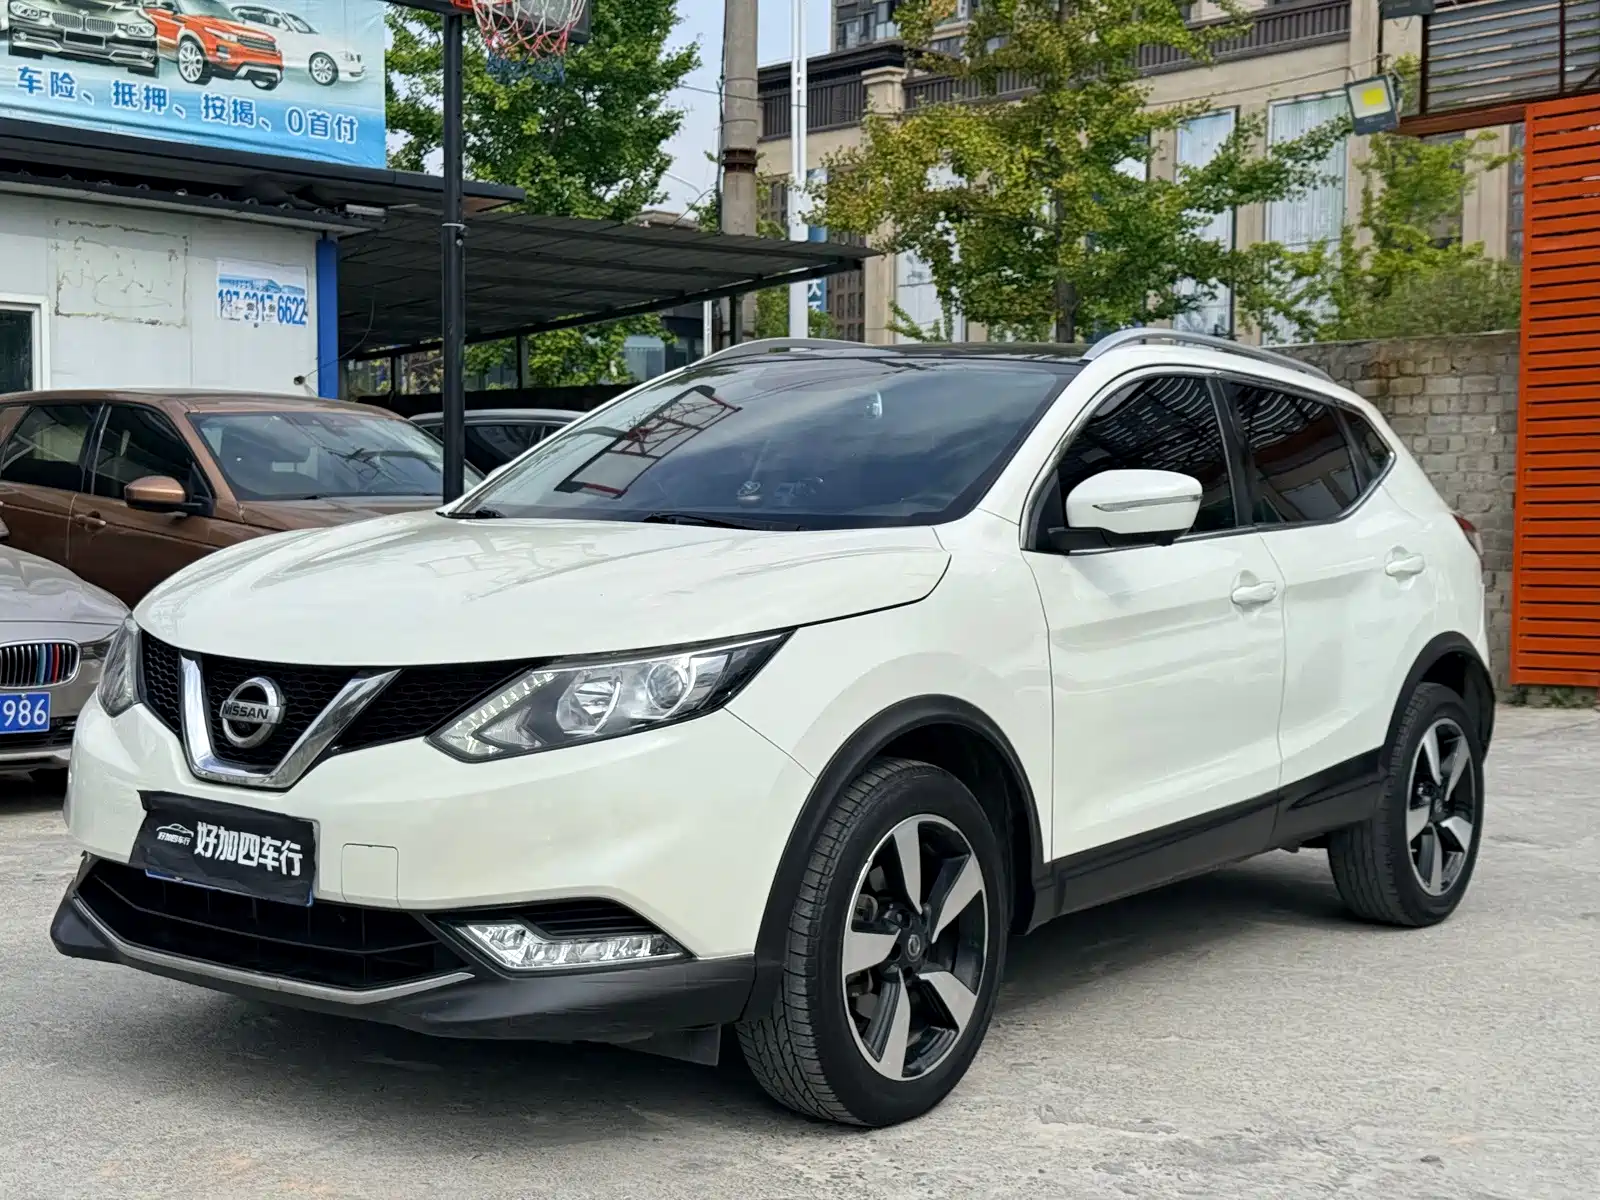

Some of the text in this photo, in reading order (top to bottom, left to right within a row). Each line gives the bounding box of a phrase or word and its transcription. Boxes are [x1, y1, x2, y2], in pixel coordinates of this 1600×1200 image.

[277, 295, 307, 325] 6622
[0, 698, 48, 727] 986
[222, 702, 270, 720] NISSAN
[194, 820, 303, 877] 好加四车行
